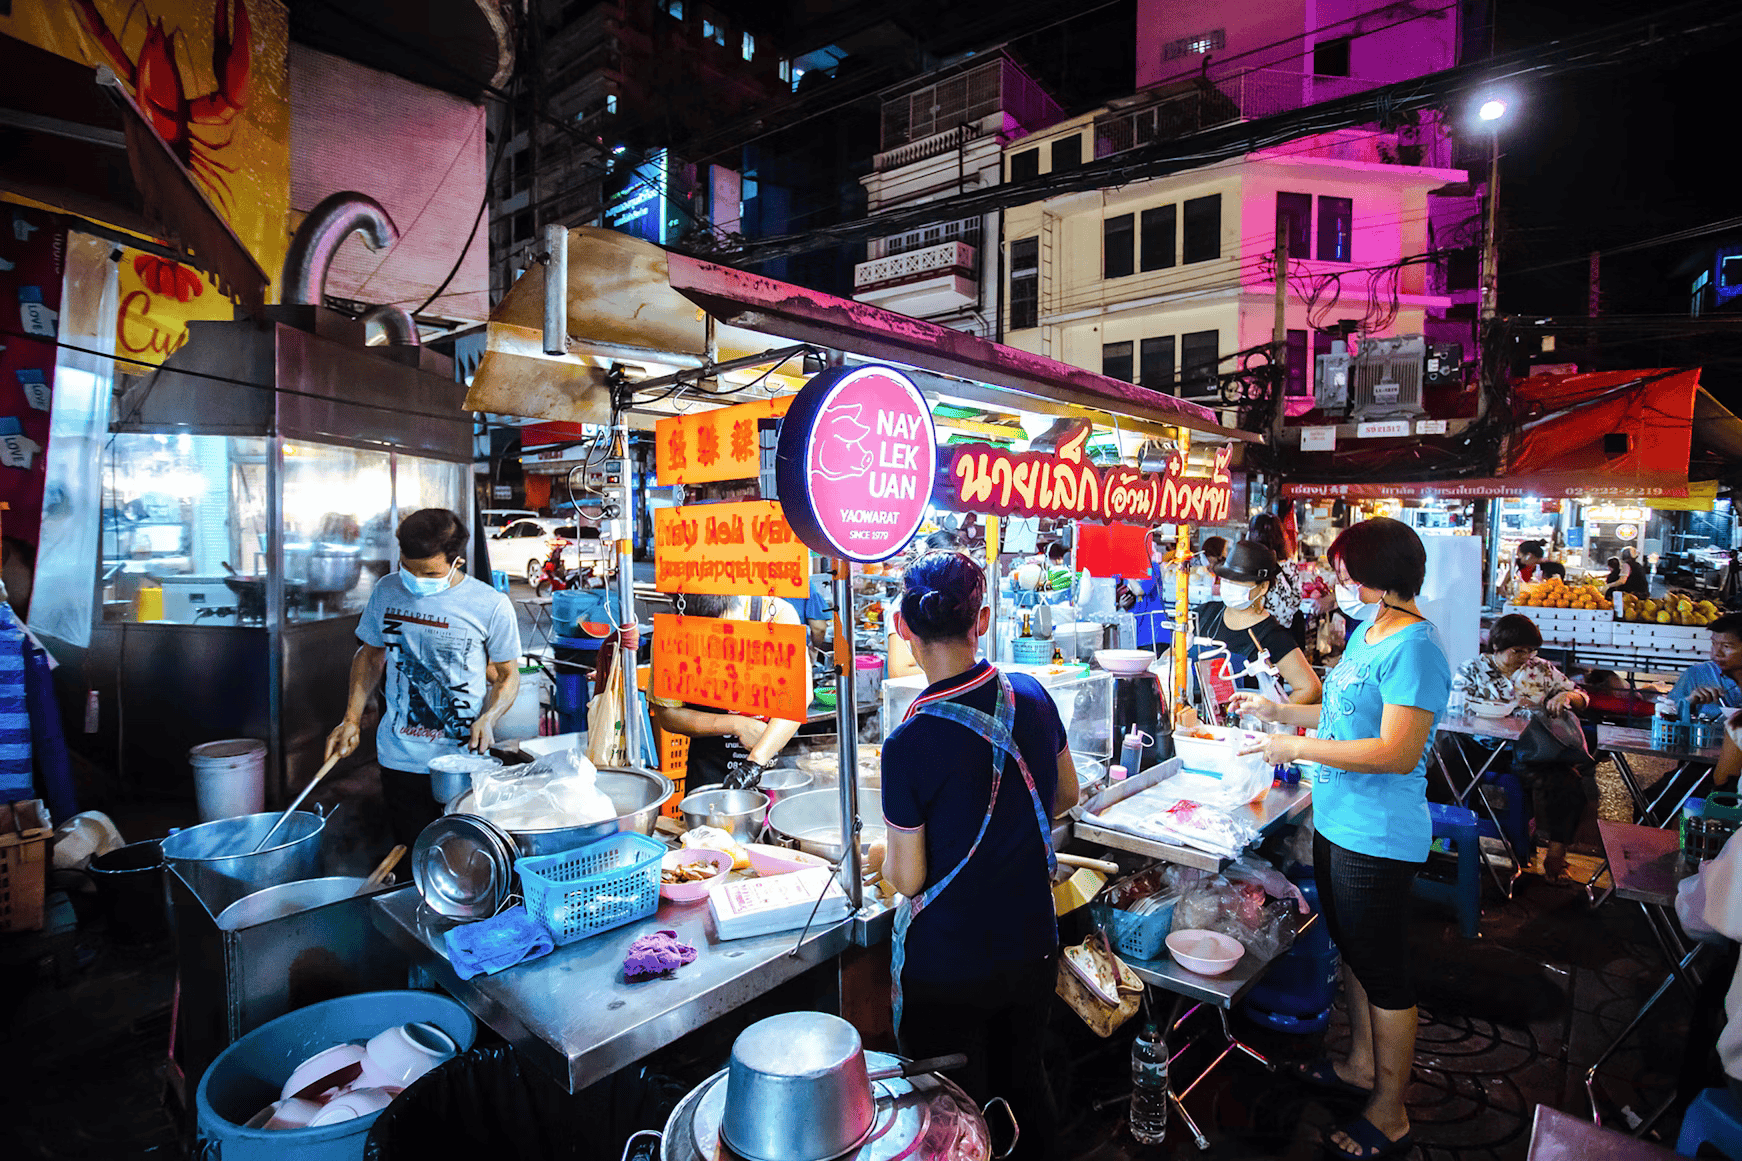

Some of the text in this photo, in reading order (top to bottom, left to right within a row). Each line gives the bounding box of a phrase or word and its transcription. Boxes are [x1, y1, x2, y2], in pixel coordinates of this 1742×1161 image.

[28, 304, 43, 331] LOVE
[876, 408, 922, 440] NAY
[5, 437, 24, 462] LOVE
[879, 440, 920, 470] LEK
[868, 471, 917, 501] UAN
[1565, 487, 1663, 496] 02-222-2219
[840, 508, 900, 525] YAOWARAT
[849, 529, 889, 541] SINCE 1979
[400, 723, 444, 743] vintage
